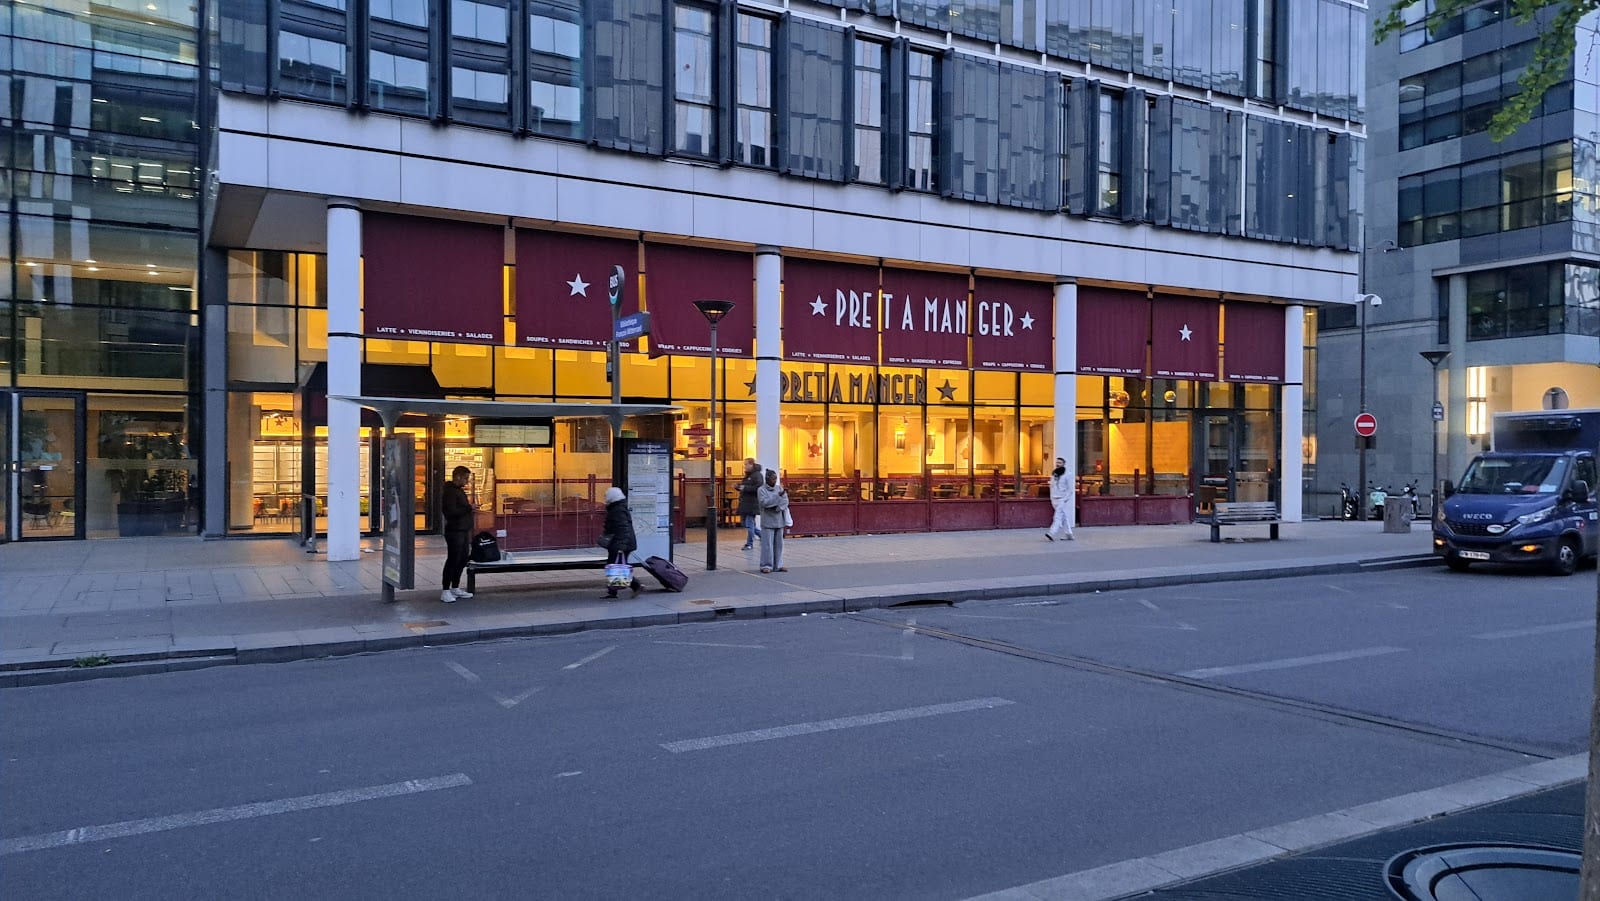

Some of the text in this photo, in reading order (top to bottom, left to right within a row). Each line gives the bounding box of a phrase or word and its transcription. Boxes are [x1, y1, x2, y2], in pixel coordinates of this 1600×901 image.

[609, 274, 619, 289] BUS
[901, 294, 914, 331] A
[376, 326, 398, 334] LATTE
[407, 328, 455, 337] VIENNOISERIES
[558, 338, 593, 346] SANDWICHES
[779, 370, 926, 404] PRET A MANGER
